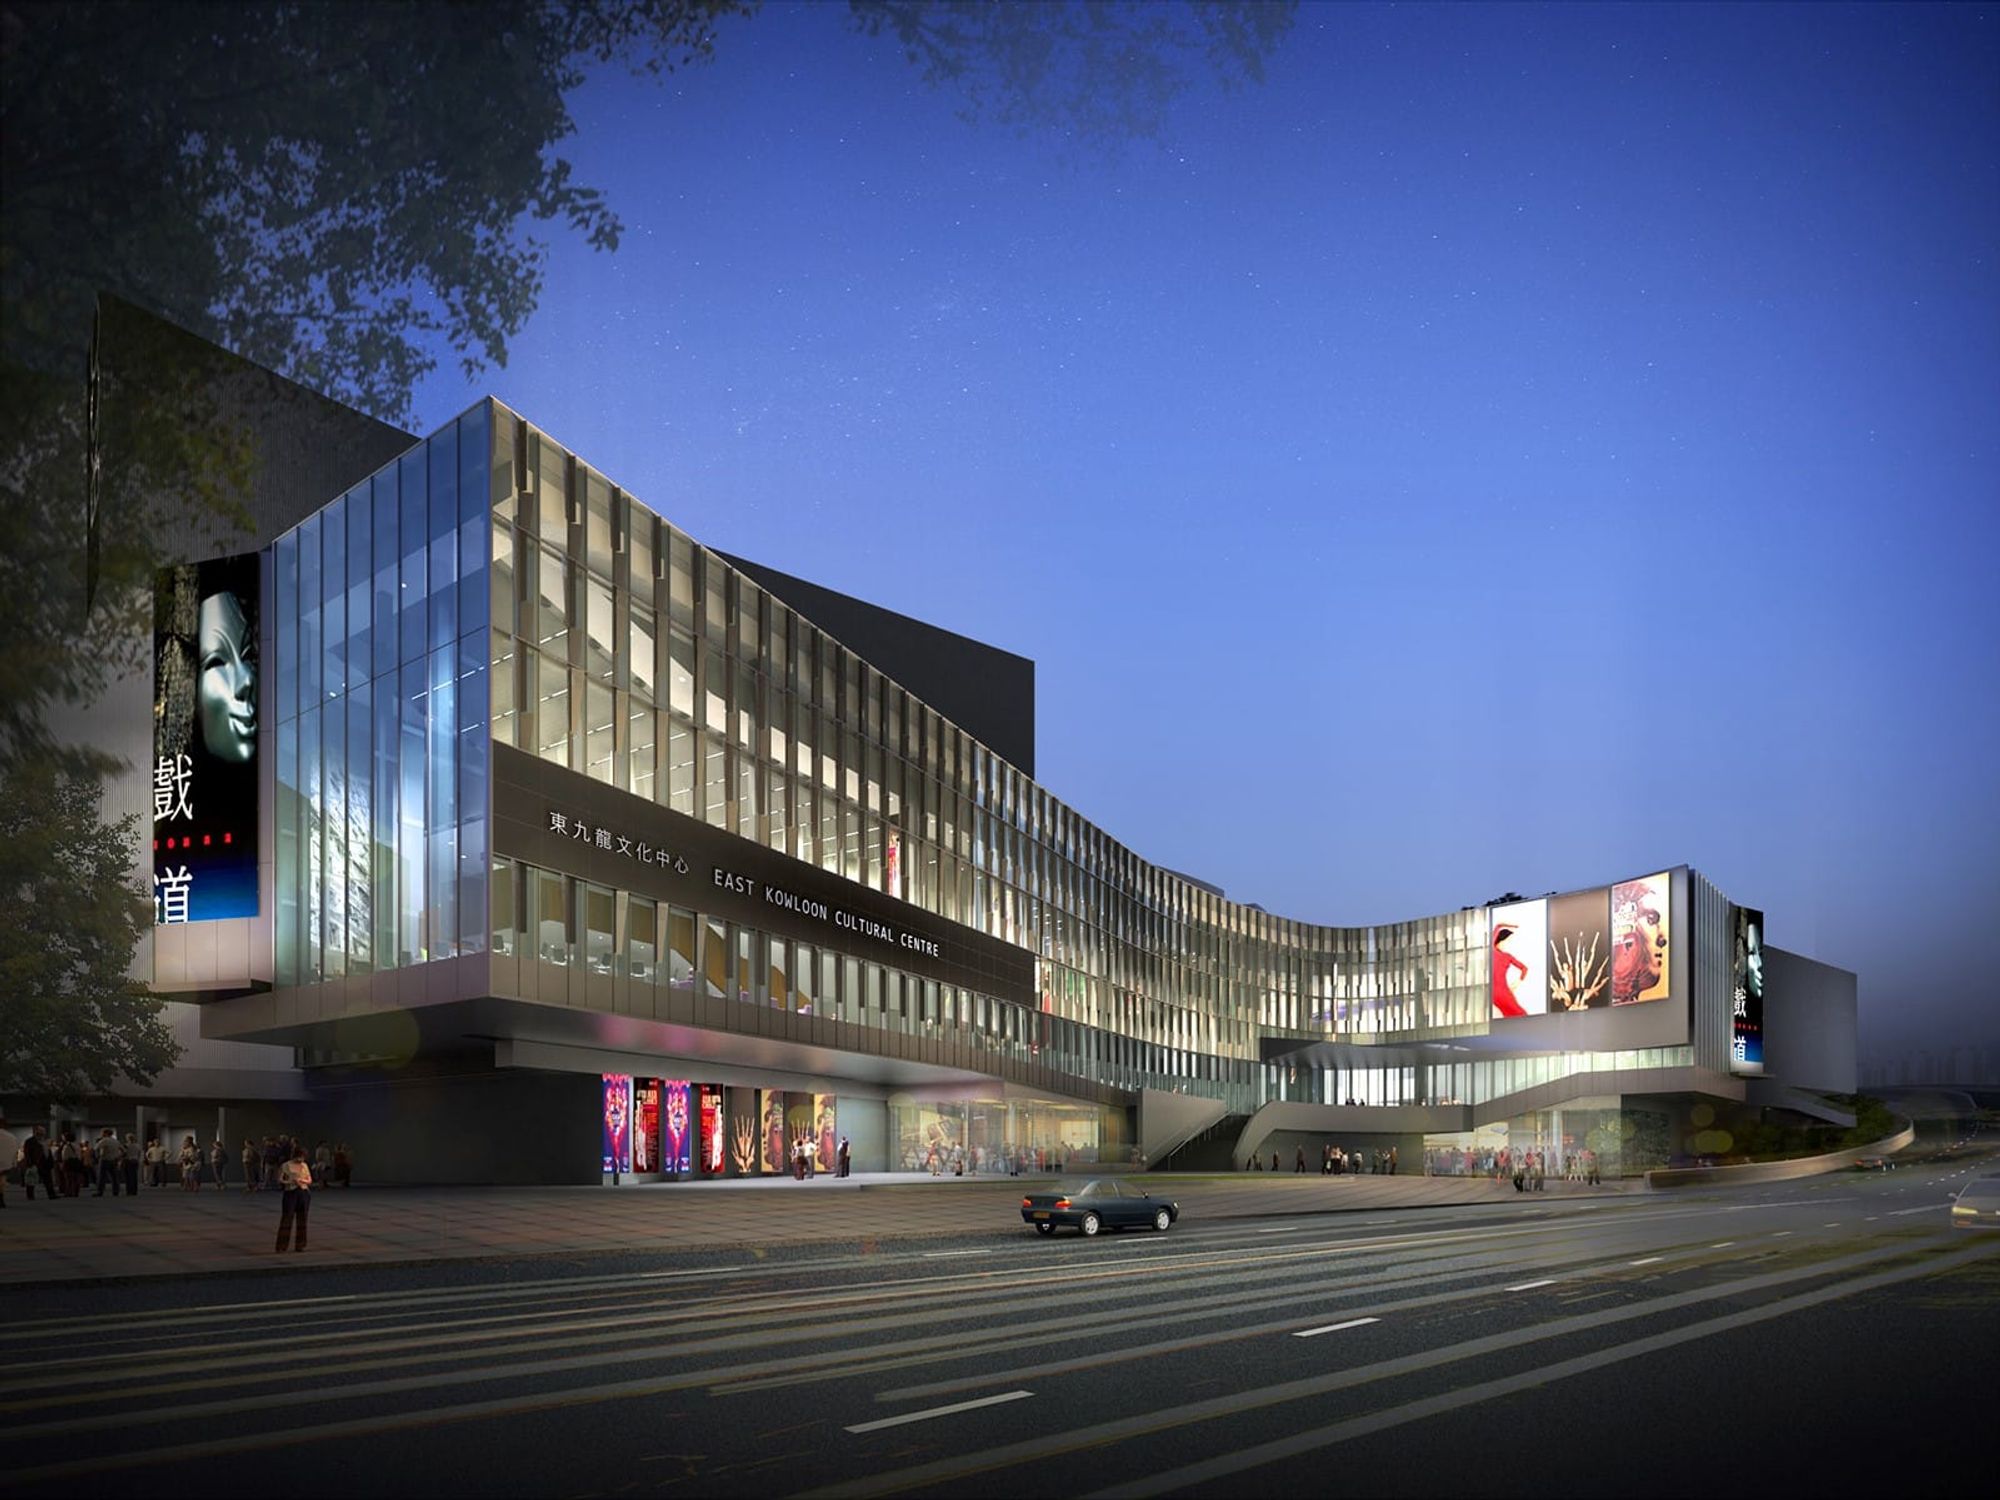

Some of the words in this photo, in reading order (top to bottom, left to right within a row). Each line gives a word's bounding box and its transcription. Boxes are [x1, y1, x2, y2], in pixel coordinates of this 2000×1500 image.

[549, 811, 689, 874] 東九龍文化中心
[714, 868, 754, 896] EAST
[765, 886, 828, 921] KOWLOON
[835, 910, 894, 943] CULTURAL
[900, 933, 940, 958] CENTRE
